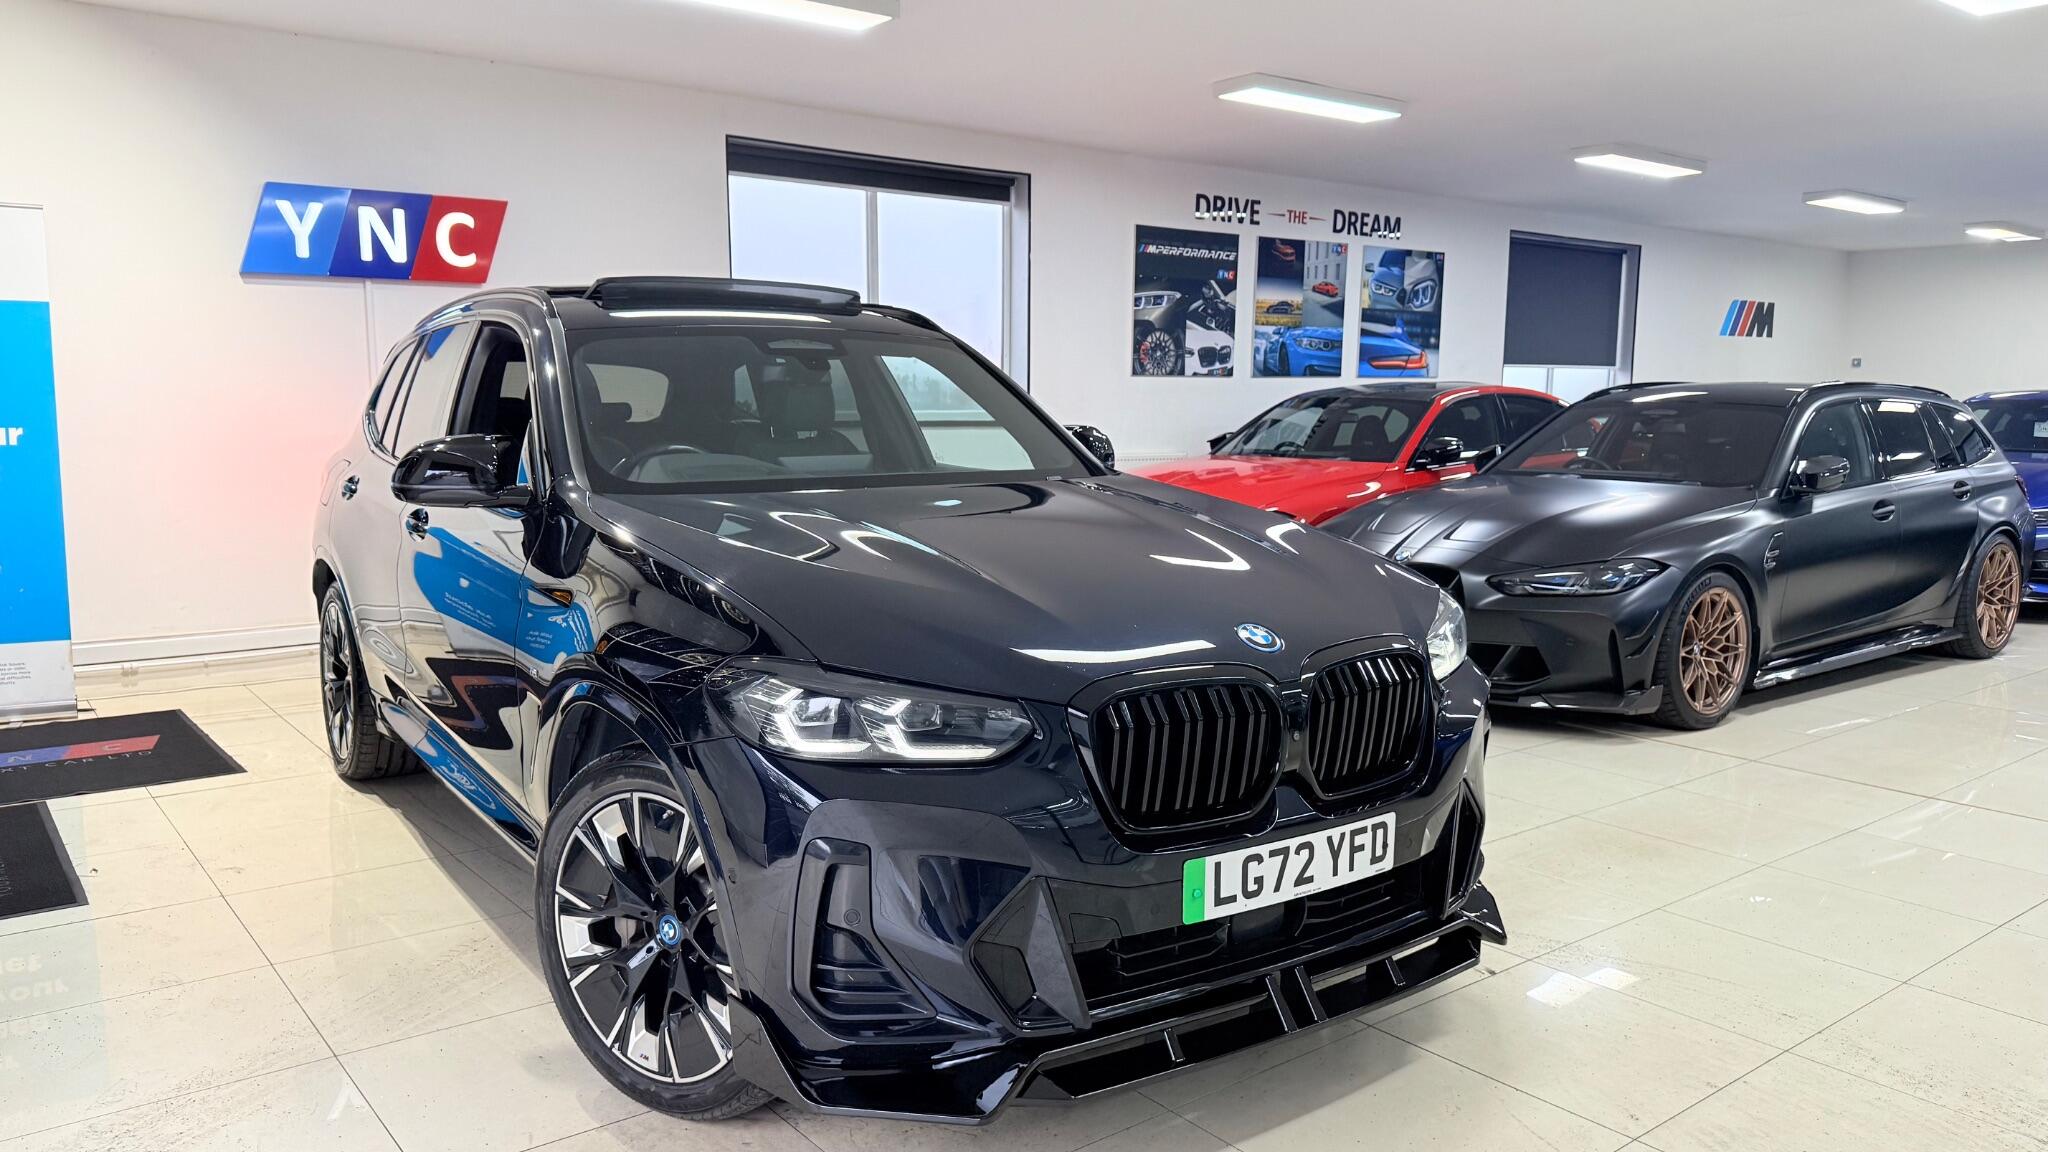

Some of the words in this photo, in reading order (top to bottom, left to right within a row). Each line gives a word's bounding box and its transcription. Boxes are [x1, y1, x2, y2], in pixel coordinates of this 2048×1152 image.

[275, 199, 477, 267] YNC
[1195, 193, 1261, 225] DRIVE
[1286, 209, 1308, 224] THE
[1332, 209, 1401, 240] DREAM
[45, 758, 94, 768] CAR
[107, 751, 152, 760] LTD
[1213, 840, 1315, 908] LG72
[1326, 820, 1389, 878] YFD
